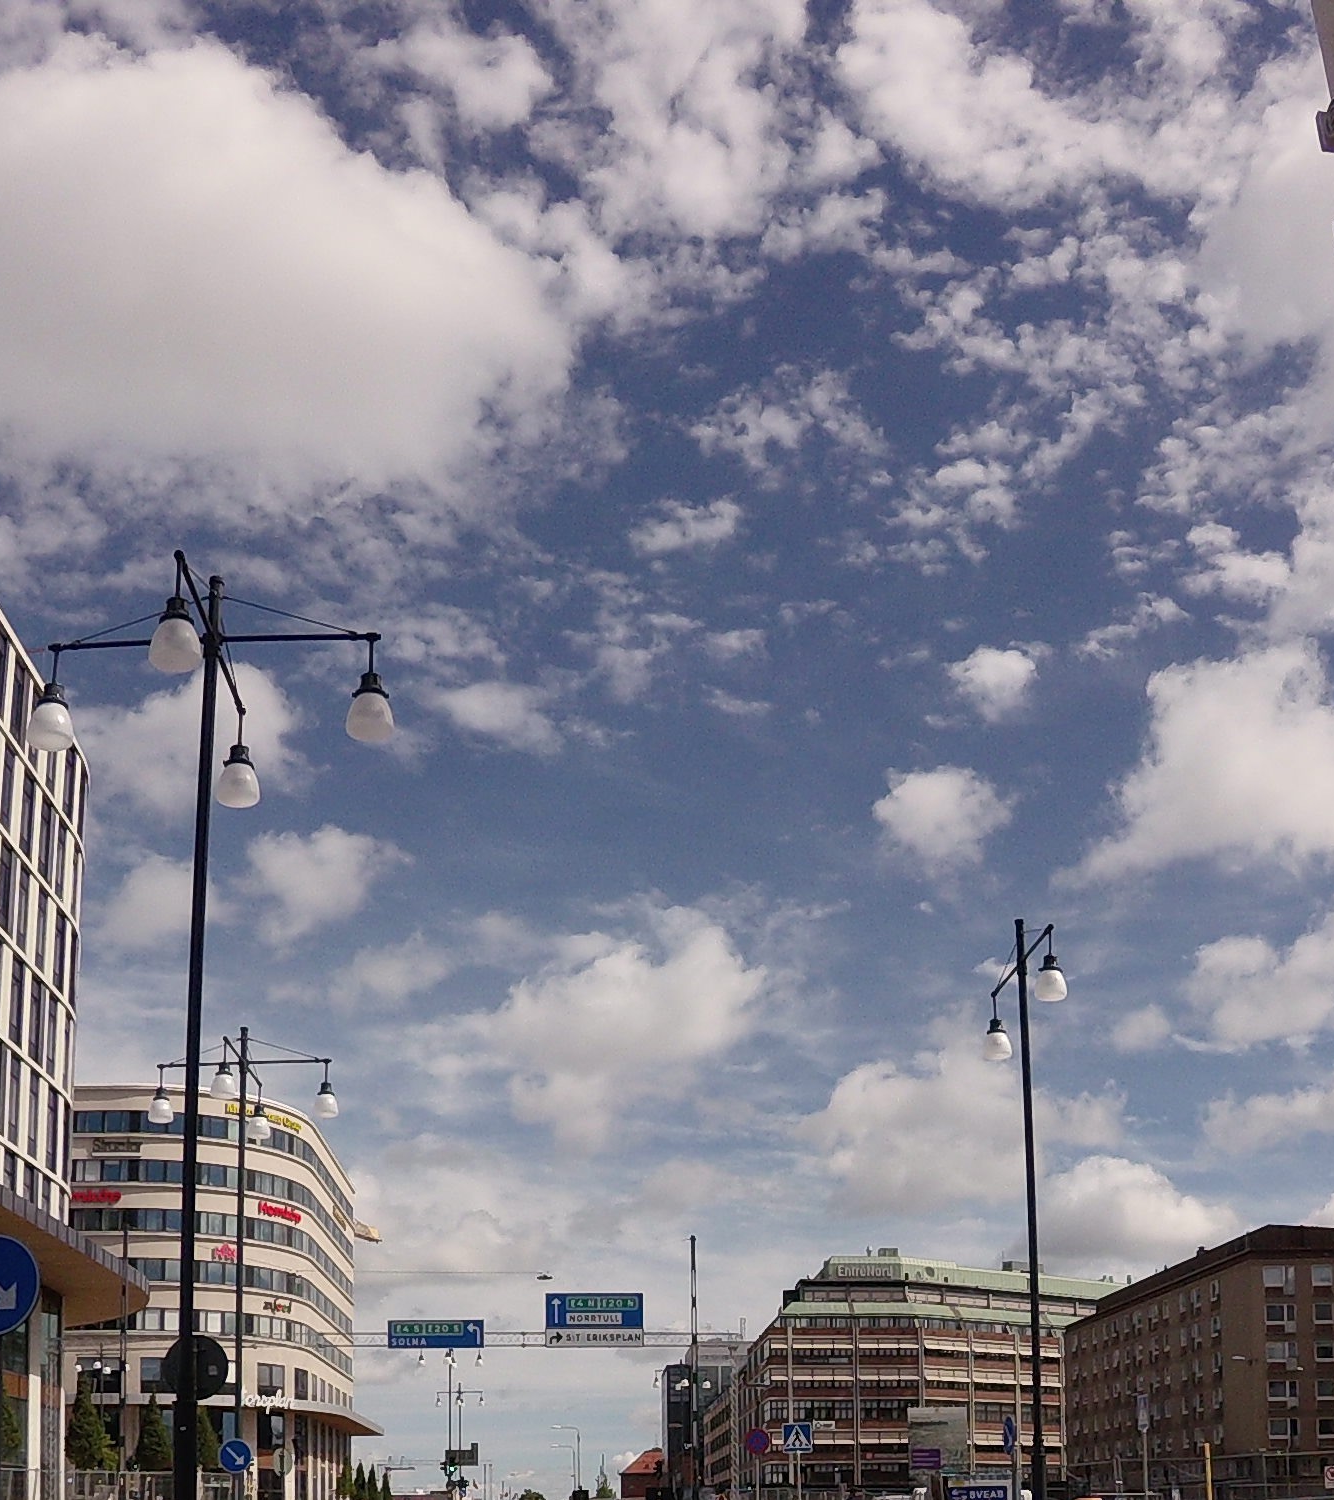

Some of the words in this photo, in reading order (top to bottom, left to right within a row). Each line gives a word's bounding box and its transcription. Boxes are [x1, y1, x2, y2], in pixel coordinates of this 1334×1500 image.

[569, 1315, 620, 1323] NORRTULL
[391, 1337, 427, 1346] SOLNA
[586, 1333, 641, 1342] ERIKSPLAN
[242, 1388, 295, 1415] orsplan
